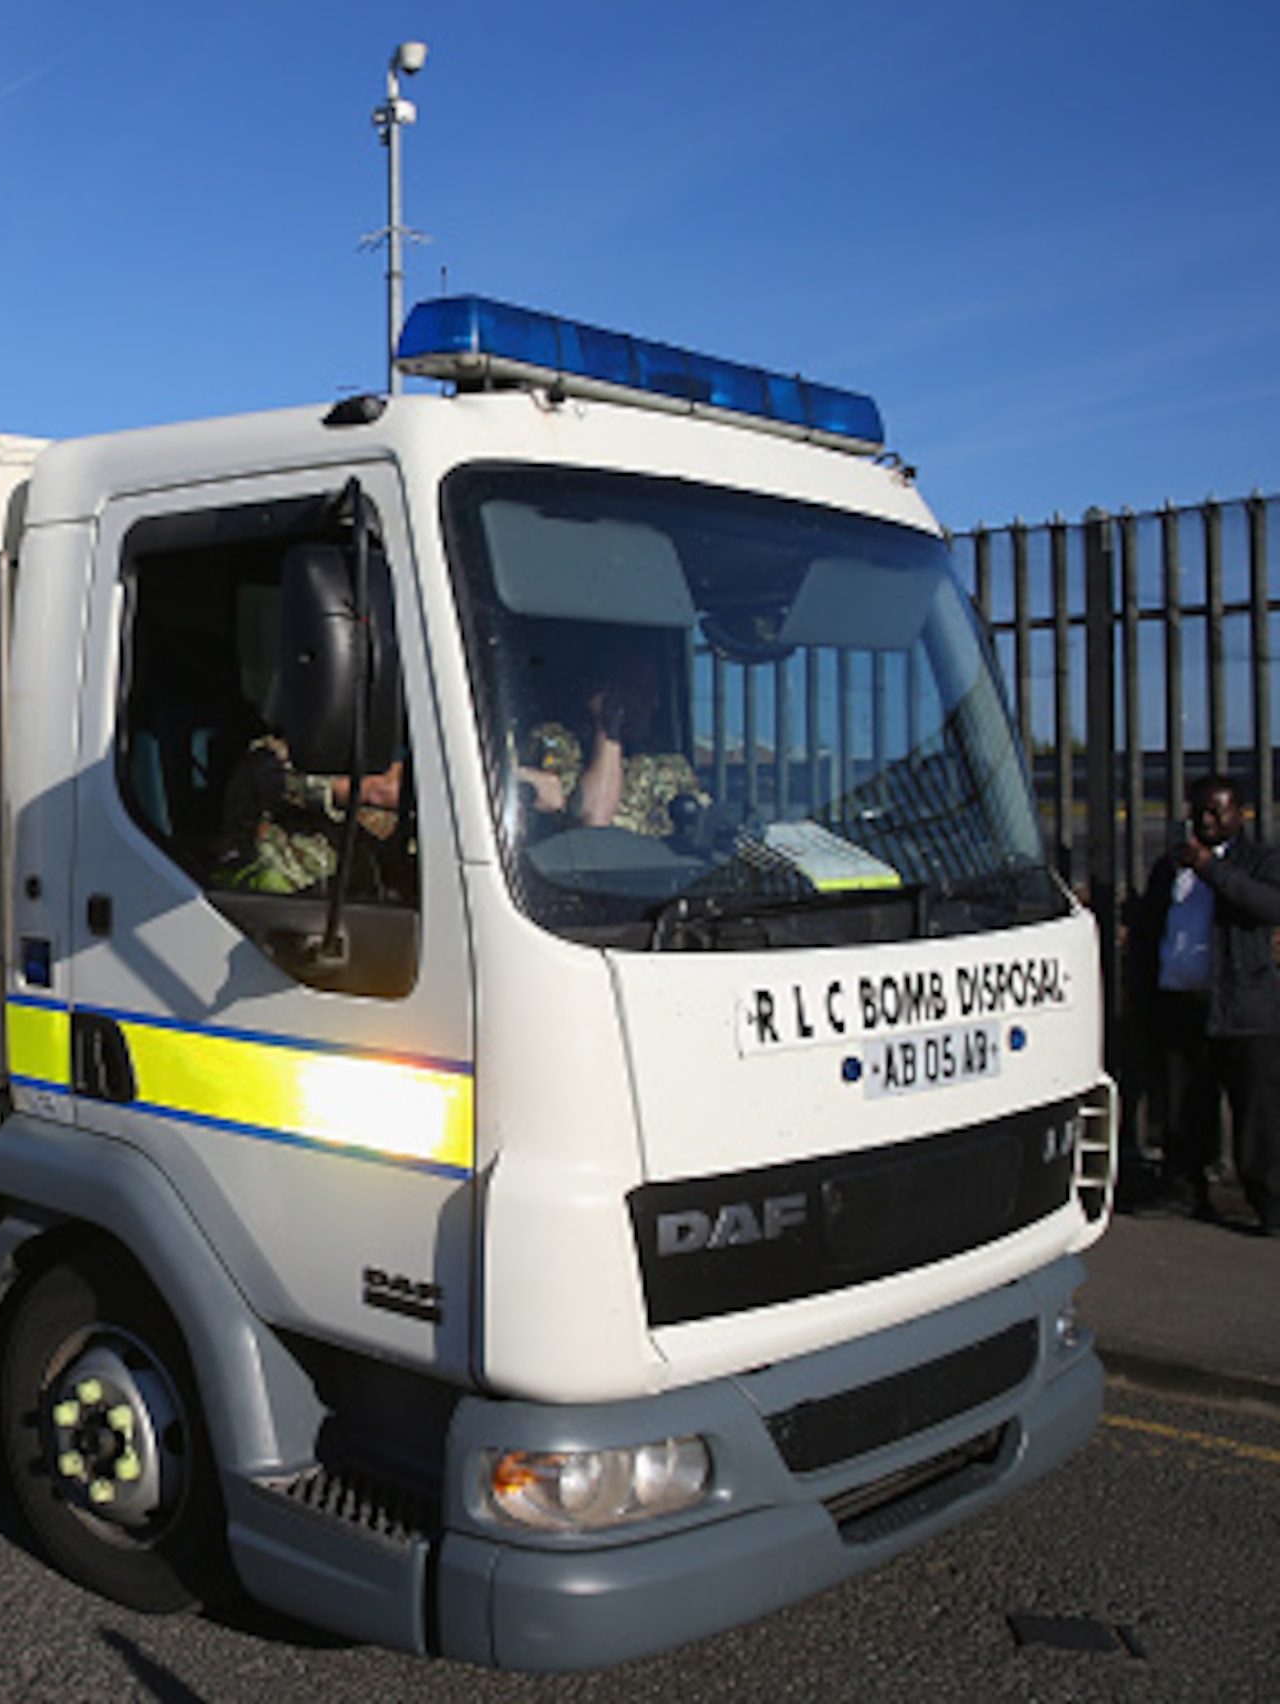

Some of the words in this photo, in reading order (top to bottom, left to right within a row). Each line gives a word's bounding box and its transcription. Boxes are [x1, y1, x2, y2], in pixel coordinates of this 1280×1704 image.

[756, 988, 780, 1043] R
[793, 984, 814, 1038] L
[826, 980, 845, 1034] C
[858, 971, 947, 1029] BOMB
[956, 957, 1065, 1016] DISPOSAL
[884, 1042, 917, 1089] AB
[924, 1033, 956, 1083] 05
[656, 1192, 808, 1259] DAF
